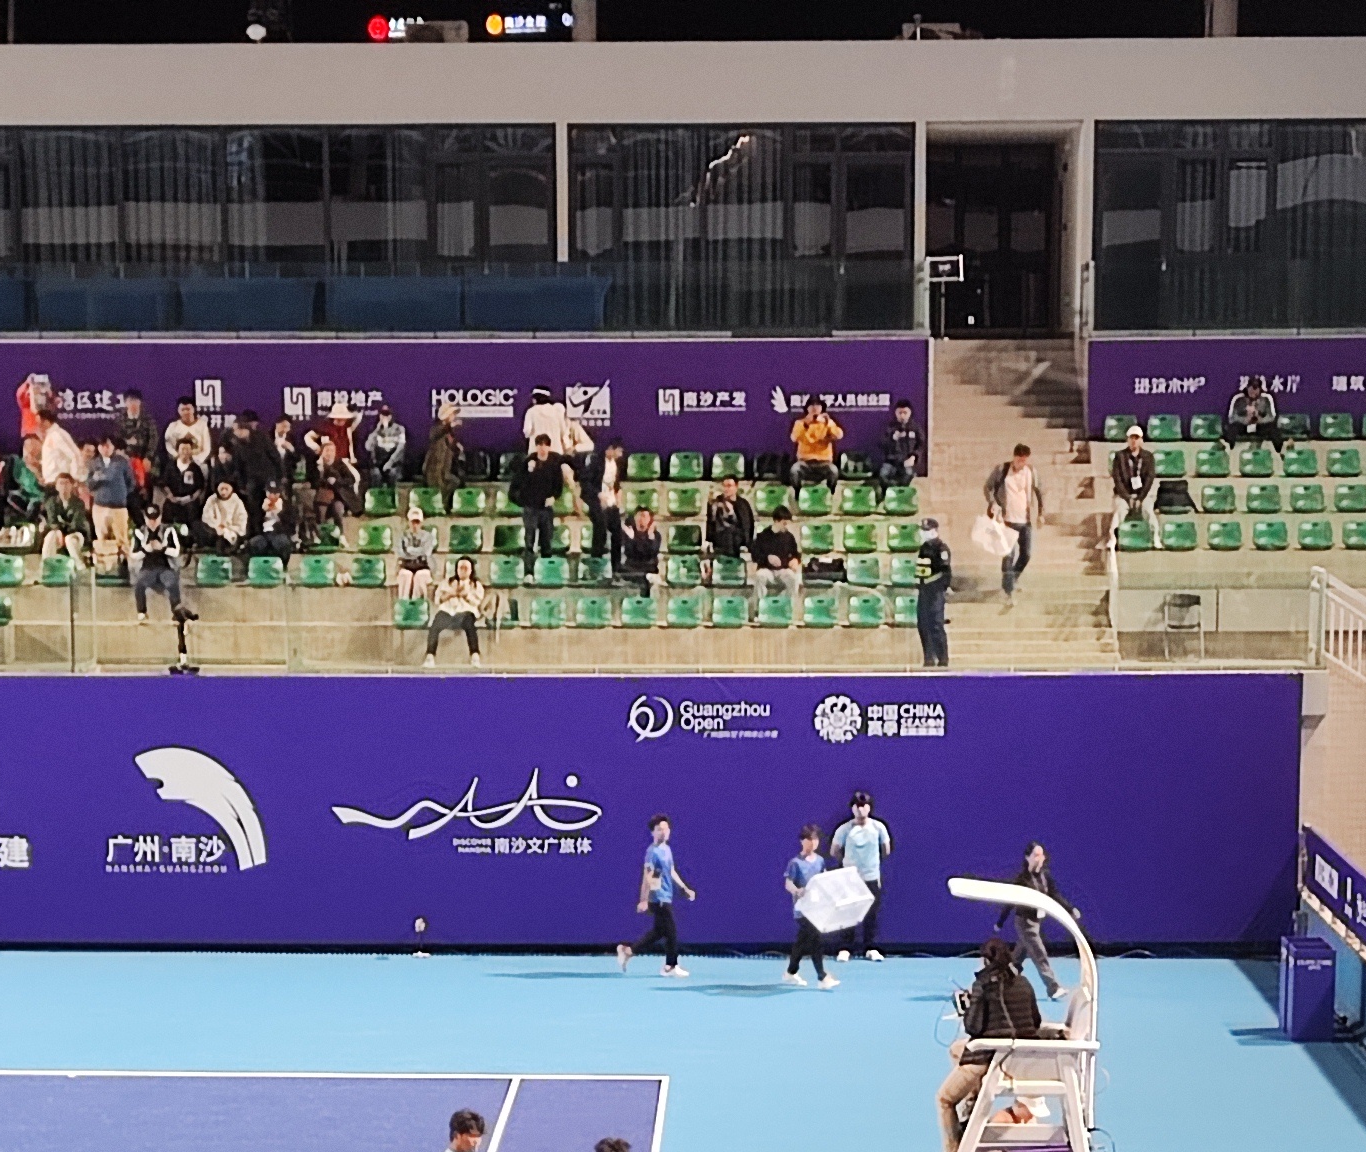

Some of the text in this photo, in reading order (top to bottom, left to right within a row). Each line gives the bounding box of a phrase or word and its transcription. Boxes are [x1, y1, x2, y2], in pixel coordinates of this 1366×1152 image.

[431, 388, 514, 405] HOLOGIC
[589, 408, 608, 416] CTA
[680, 701, 770, 720] Guangzhou
[867, 704, 898, 720] 中国
[900, 703, 945, 718] CHINA
[680, 717, 724, 733] Open
[106, 834, 226, 863] 广州·南沙
[494, 837, 592, 854] 南沙文广旅体
